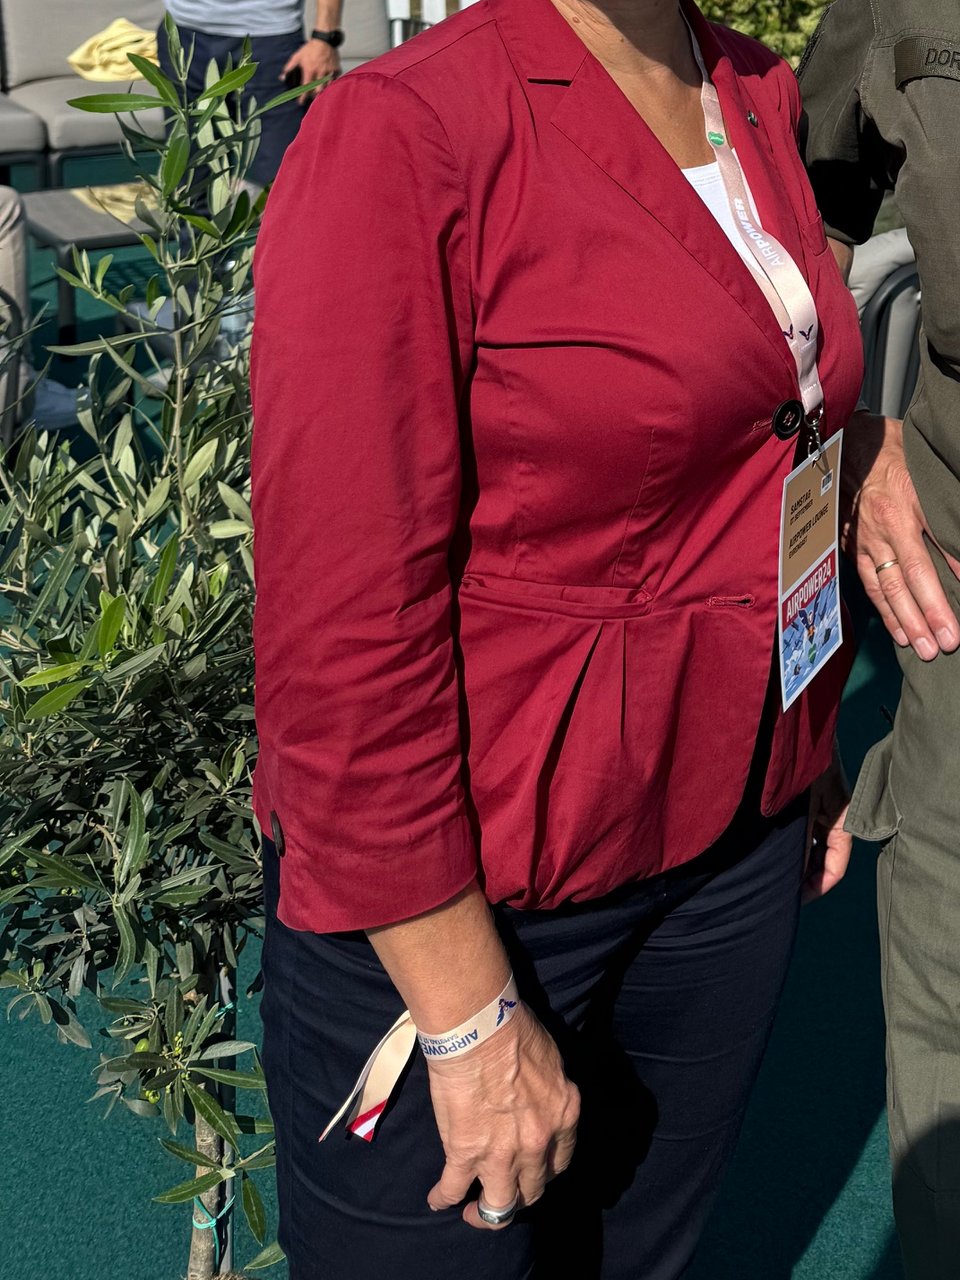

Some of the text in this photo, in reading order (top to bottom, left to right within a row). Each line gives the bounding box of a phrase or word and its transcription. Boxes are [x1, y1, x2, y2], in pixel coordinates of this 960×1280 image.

[733, 197, 785, 266] AIRPOWER
[786, 558, 832, 622] AIRPOWER24
[422, 1028, 479, 1056] AIRPOWE
